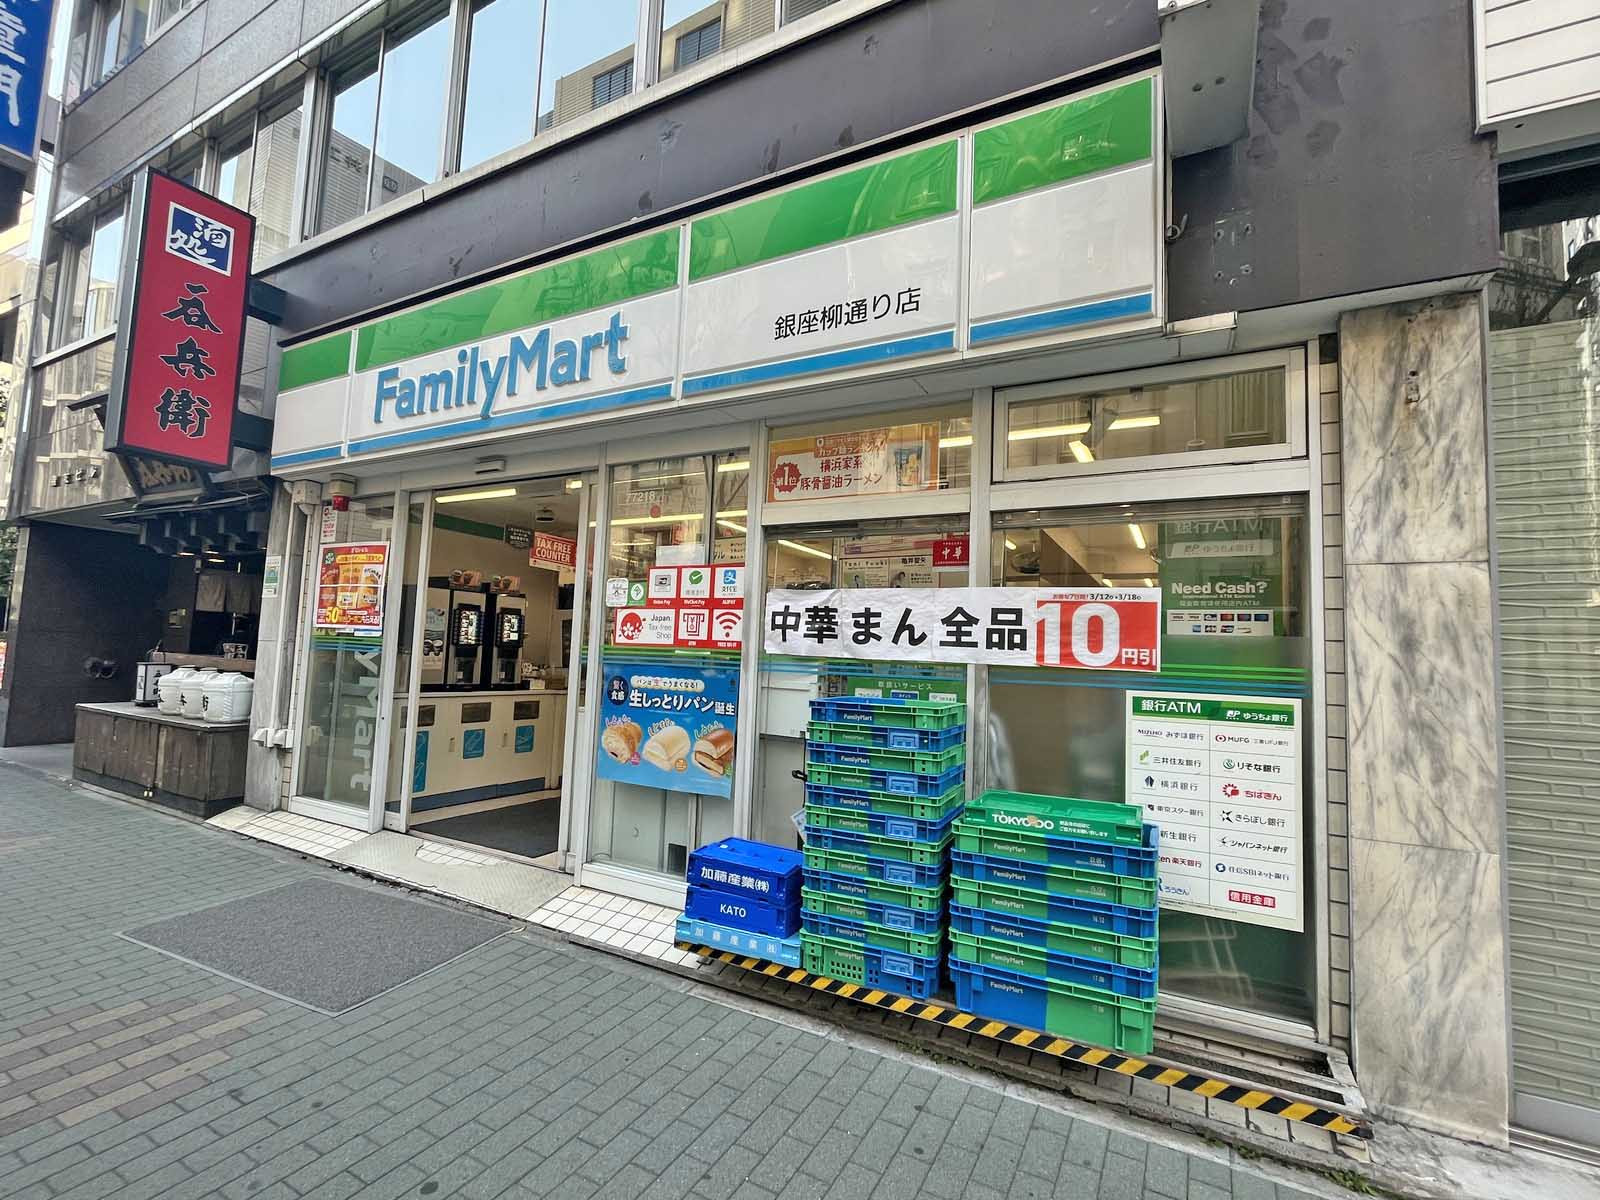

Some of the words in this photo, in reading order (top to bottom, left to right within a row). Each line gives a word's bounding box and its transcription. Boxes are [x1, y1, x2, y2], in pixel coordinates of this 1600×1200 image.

[774, 287, 921, 341] 銀座柳通り店
[373, 310, 630, 424] FamilyMart
[800, 473, 882, 491] 豚骨醤油ラーメン
[536, 537, 552, 549] TAX
[553, 541, 572, 554] FREE
[535, 547, 571, 562] COUNTER
[1171, 582, 1212, 594] Need
[1215, 581, 1269, 594] Cash?
[1141, 699, 1201, 714] 銀行ATM
[843, 714, 873, 722] FamilyMart
[1243, 713, 1289, 722] ゆうちょ銀行
[841, 755, 870, 764] FamilyMart
[1153, 757, 1202, 768] 三井住友銀行
[1237, 763, 1281, 774] りそな銀行
[1160, 780, 1198, 792] 横浜銀行
[840, 798, 869, 807] FamilyMart
[1157, 806, 1204, 817] 東京スター銀行
[839, 819, 869, 829] FamilyMart
[1235, 814, 1286, 828] きらぼし銀行
[1160, 830, 1197, 842] 新生銀行
[993, 843, 1026, 854] FamilyMart
[1172, 858, 1202, 868] 楽天銀行
[993, 870, 1026, 881] FamilyMart
[837, 883, 867, 894] FamilyMart
[991, 898, 1025, 909] FamilyMart
[1230, 891, 1275, 908] 信用金庫
[720, 903, 747, 918] KATO
[836, 927, 866, 938] FamilyMart
[991, 925, 1024, 938] FamilyMart
[835, 949, 865, 961] FamilyMart
[991, 953, 1024, 966] FamilyMart
[990, 981, 1024, 994] FamilyMart
